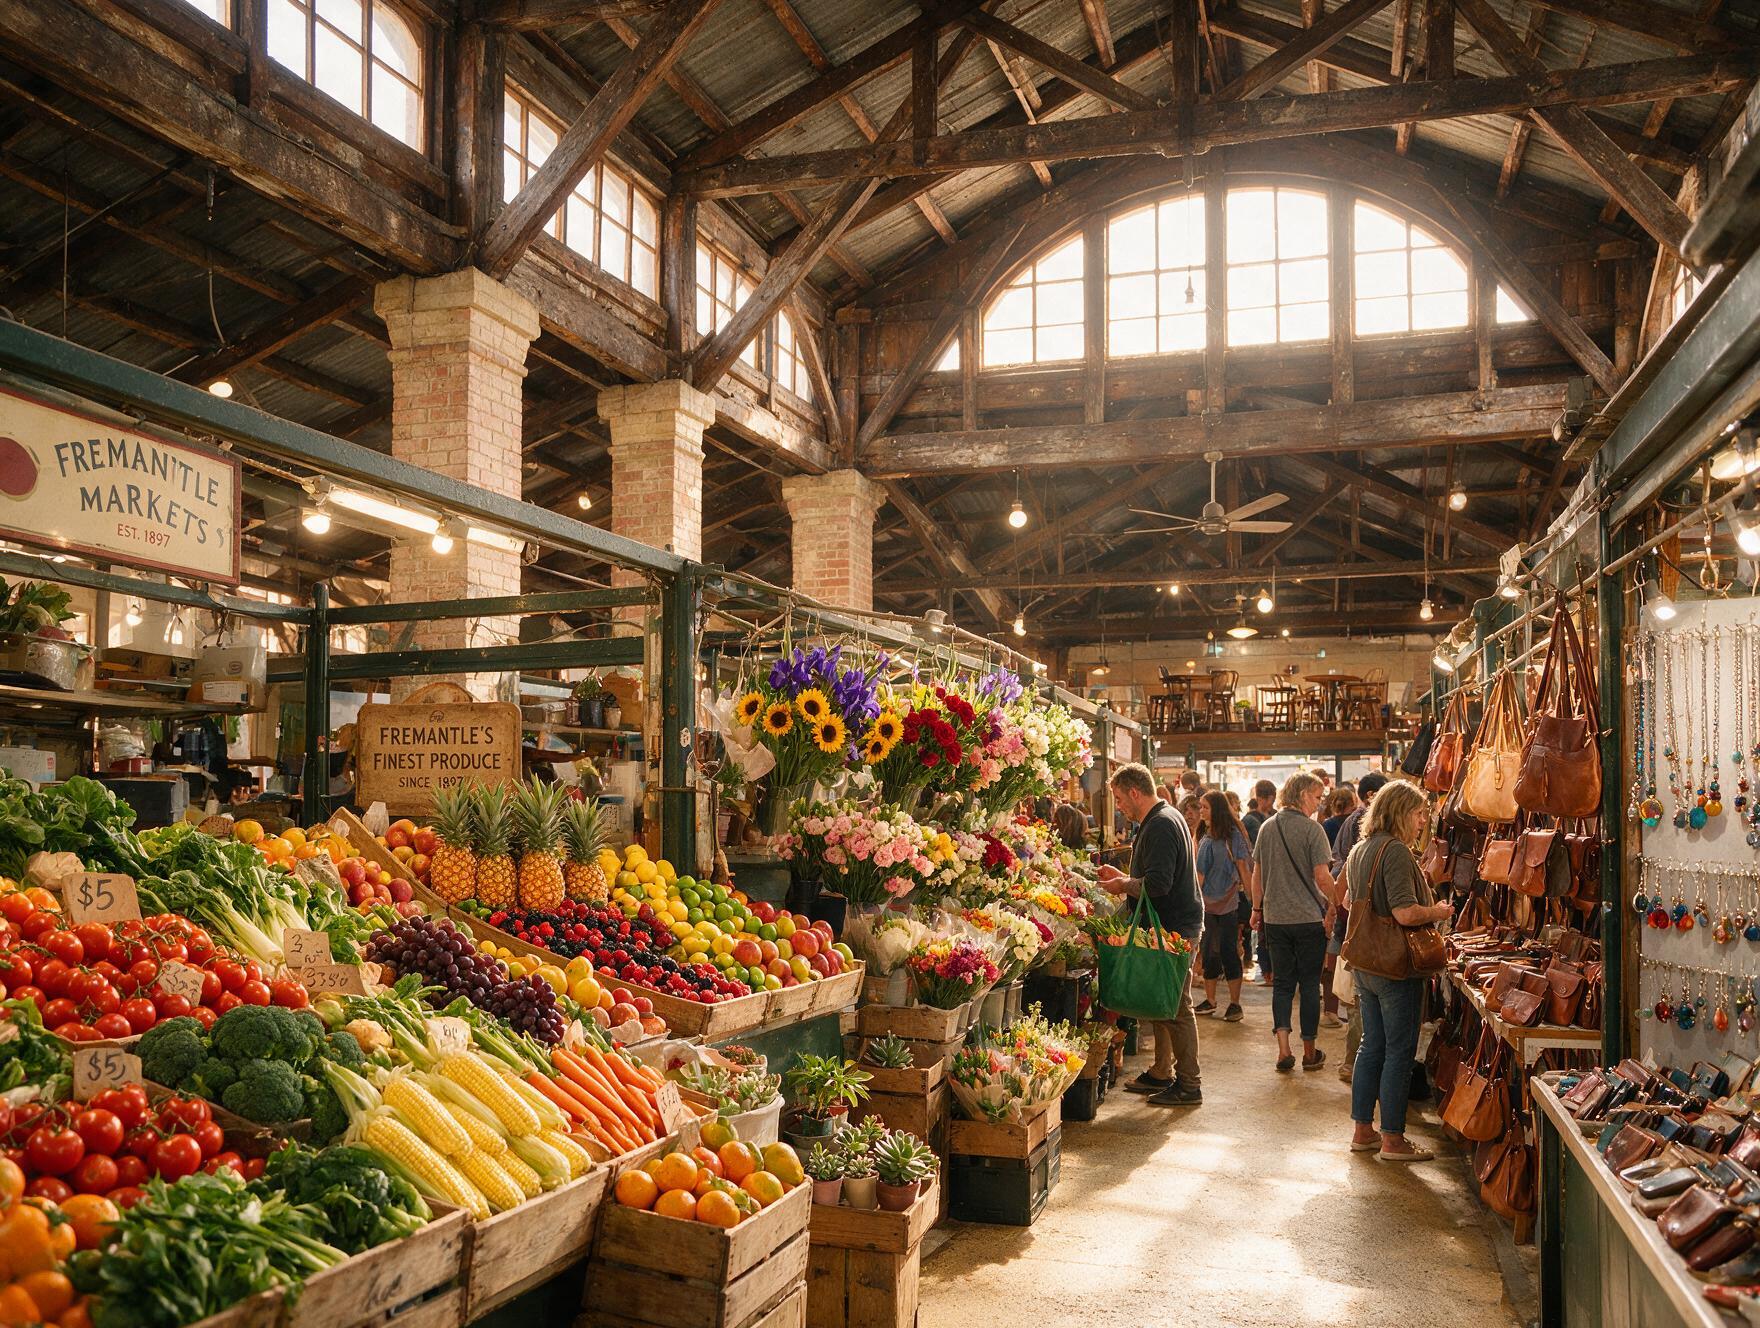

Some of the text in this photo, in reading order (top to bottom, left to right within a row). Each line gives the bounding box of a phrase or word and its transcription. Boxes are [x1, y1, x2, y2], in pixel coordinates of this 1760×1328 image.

[80, 484, 208, 545] MARKETS
[117, 523, 171, 549] EST. 1897
[380, 726, 494, 745] FREMANTLE'S
[374, 752, 502, 771] FINEST PRODUCE
[398, 776, 431, 788] SINCE
[77, 878, 115, 911] $5
